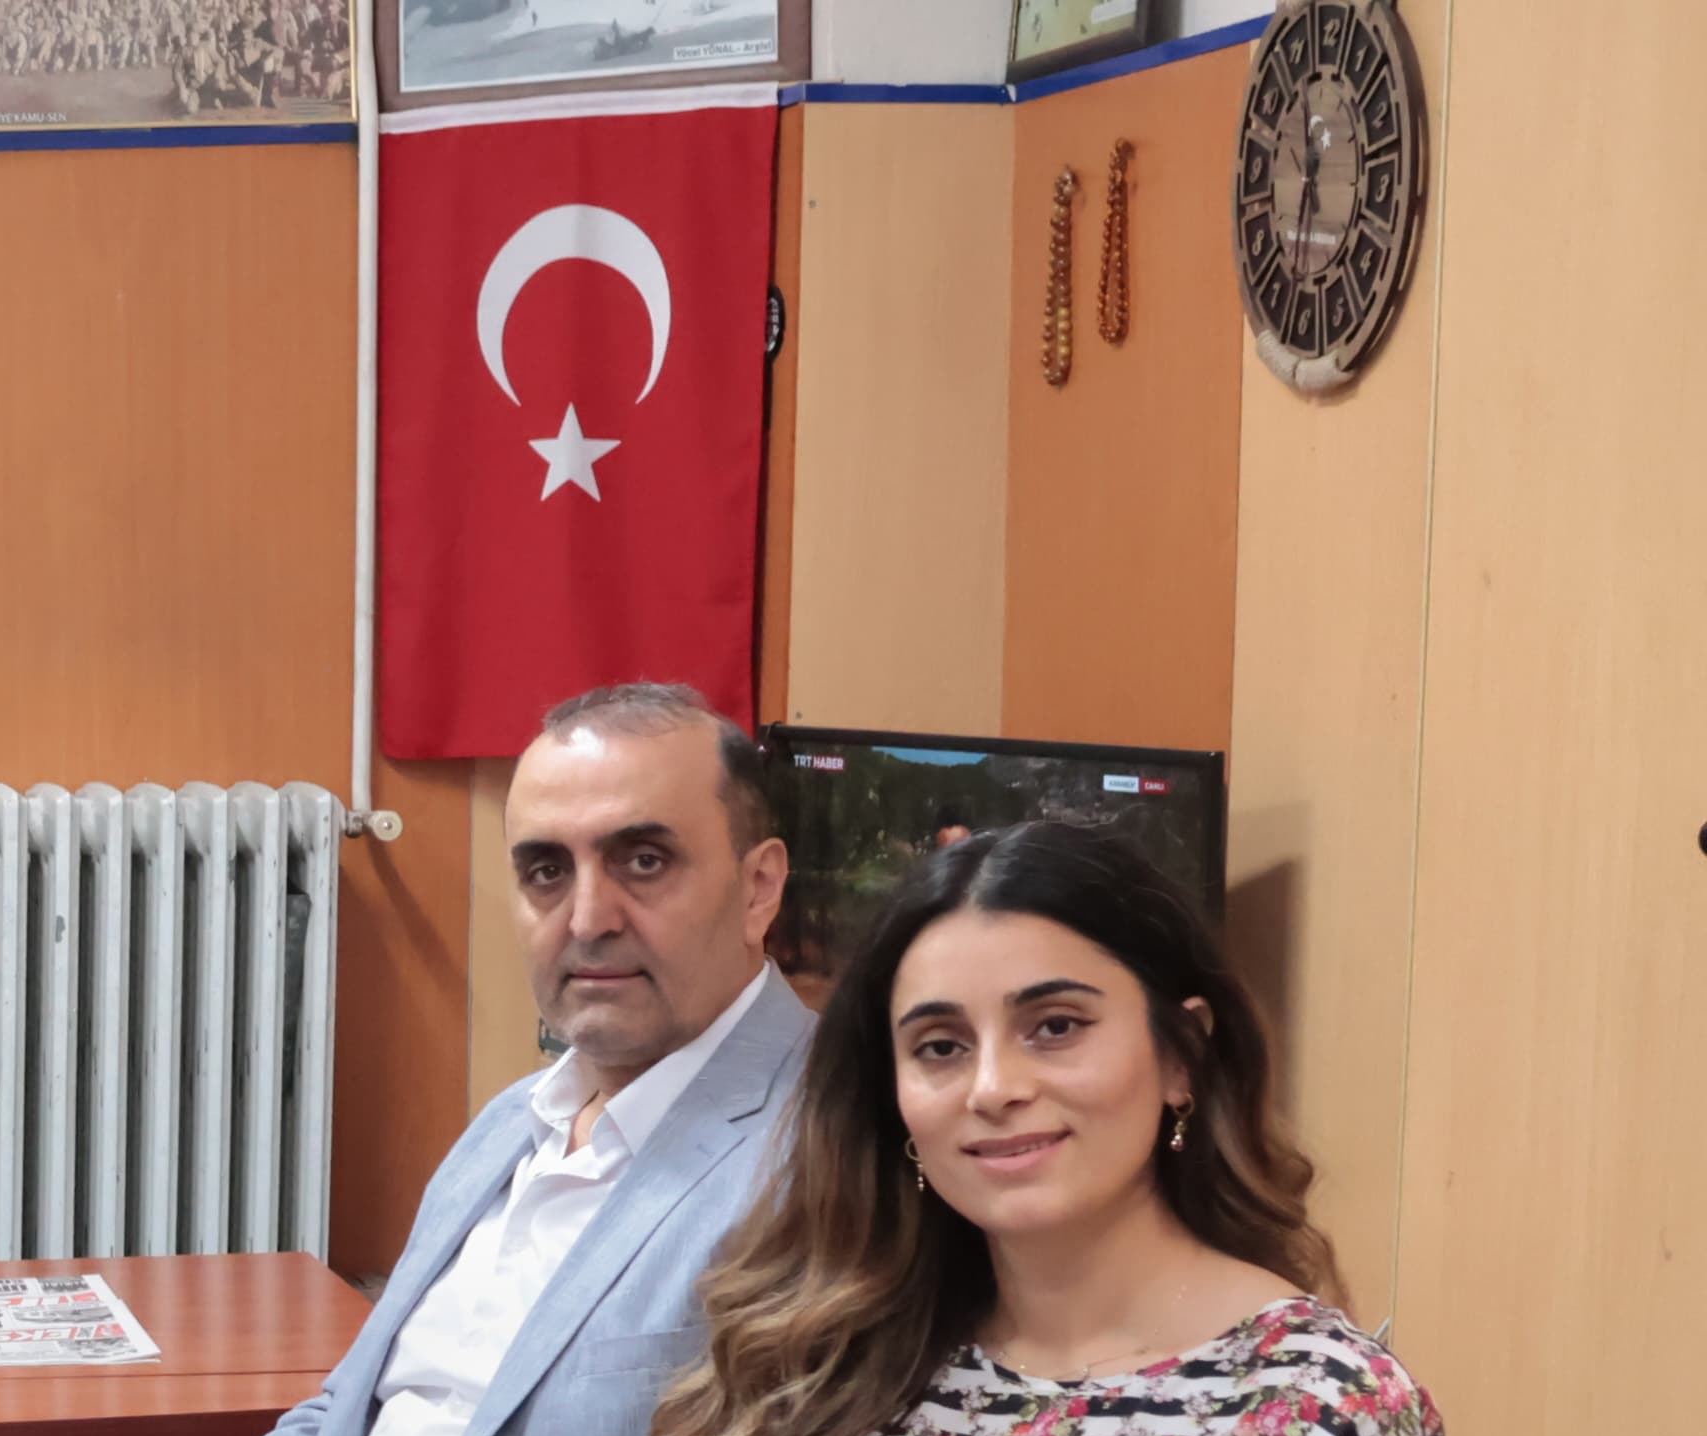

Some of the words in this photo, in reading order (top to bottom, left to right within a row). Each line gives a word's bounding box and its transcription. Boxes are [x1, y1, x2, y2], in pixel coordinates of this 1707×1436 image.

[1323, 18, 1341, 46] 12
[1290, 38, 1306, 65] 11
[1355, 47, 1367, 72] 1
[1262, 87, 1278, 115] 10
[1374, 102, 1388, 128] 2
[1249, 156, 1263, 183] 9
[1375, 174, 1390, 202] 3
[1252, 230, 1265, 256] 8
[1359, 249, 1373, 275] 4
[1271, 282, 1284, 308] 7
[1298, 308, 1311, 336] 6
[1333, 299, 1346, 327] 5
[794, 754, 812, 768] TRT
[813, 756, 844, 770] HABER
